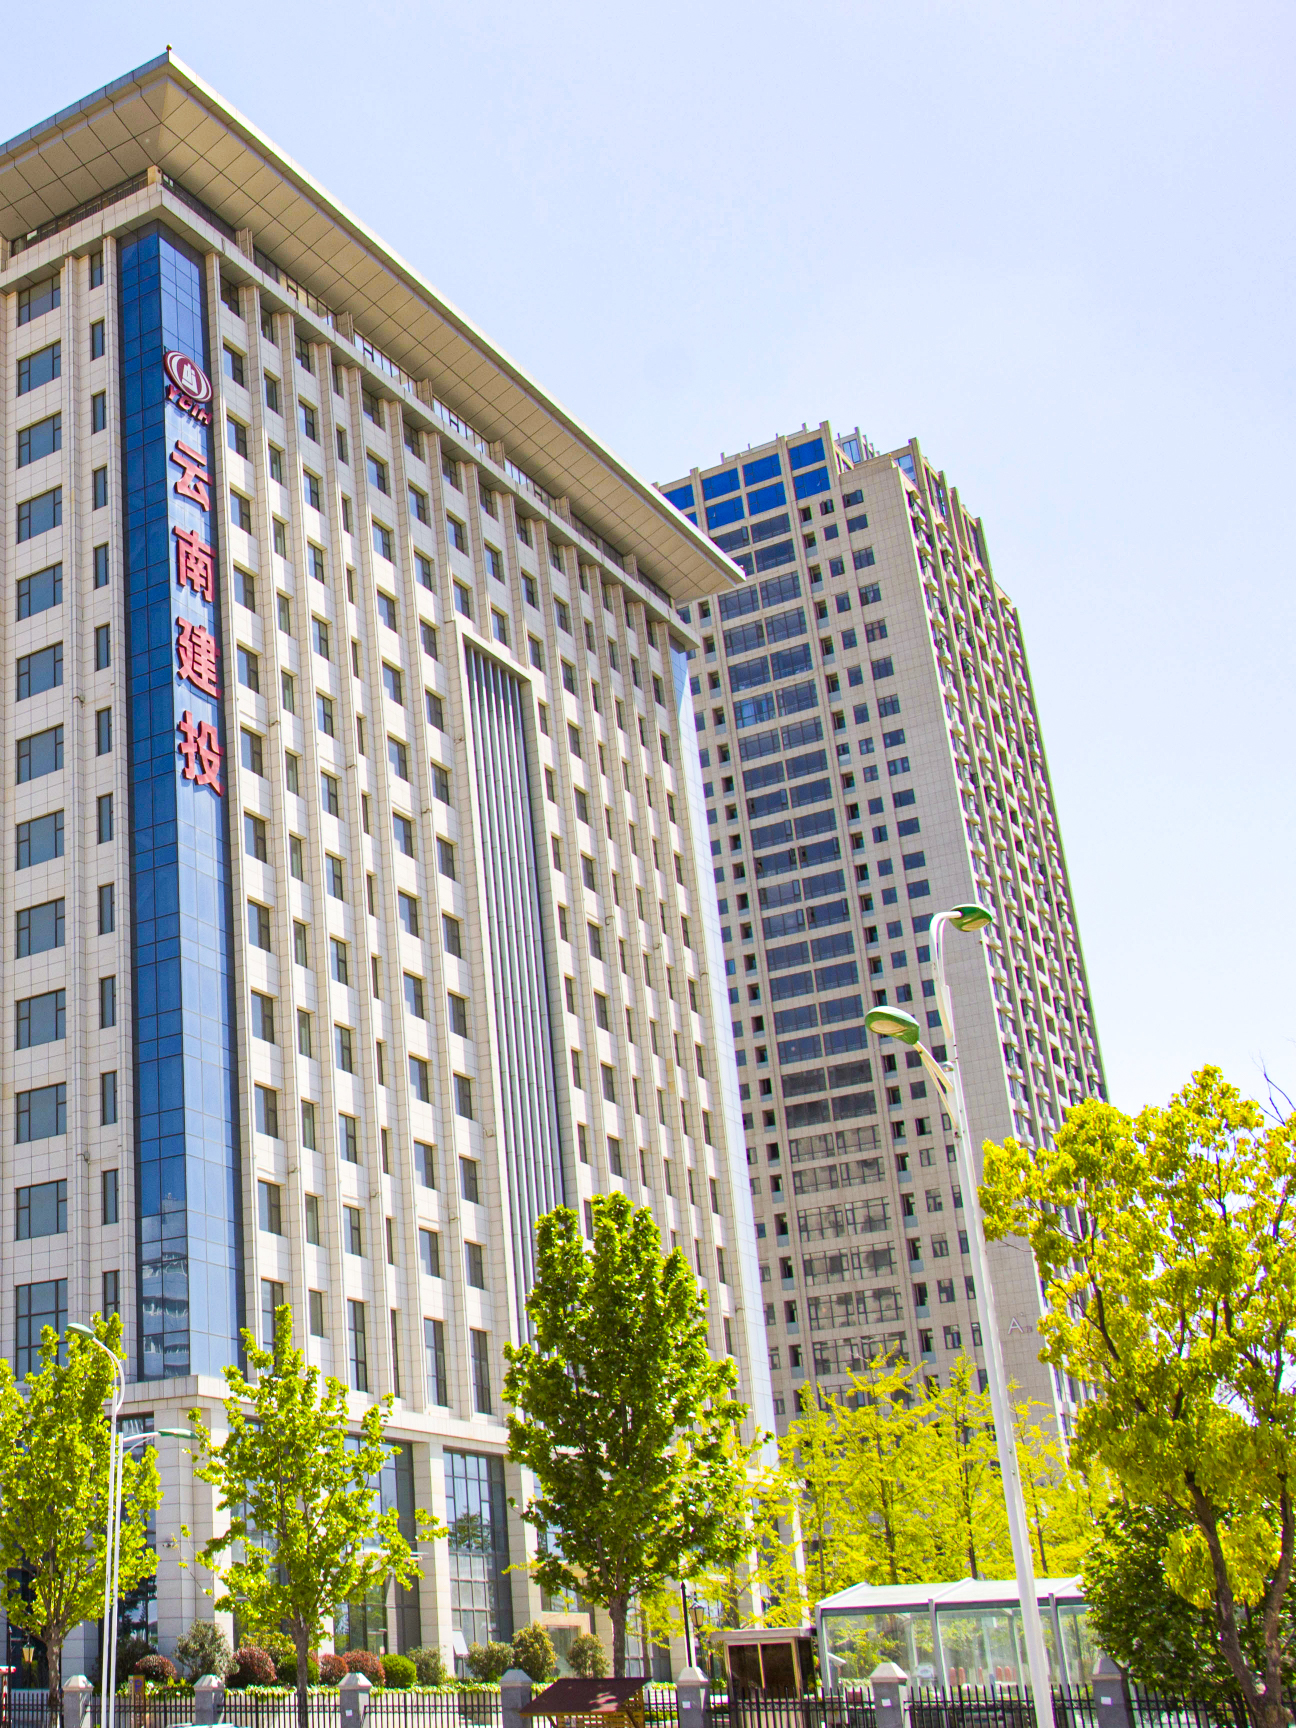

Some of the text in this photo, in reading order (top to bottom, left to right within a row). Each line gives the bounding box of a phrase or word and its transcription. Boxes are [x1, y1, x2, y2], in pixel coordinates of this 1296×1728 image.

[166, 384, 212, 427] YCIH
[170, 440, 224, 797] 云南建投
